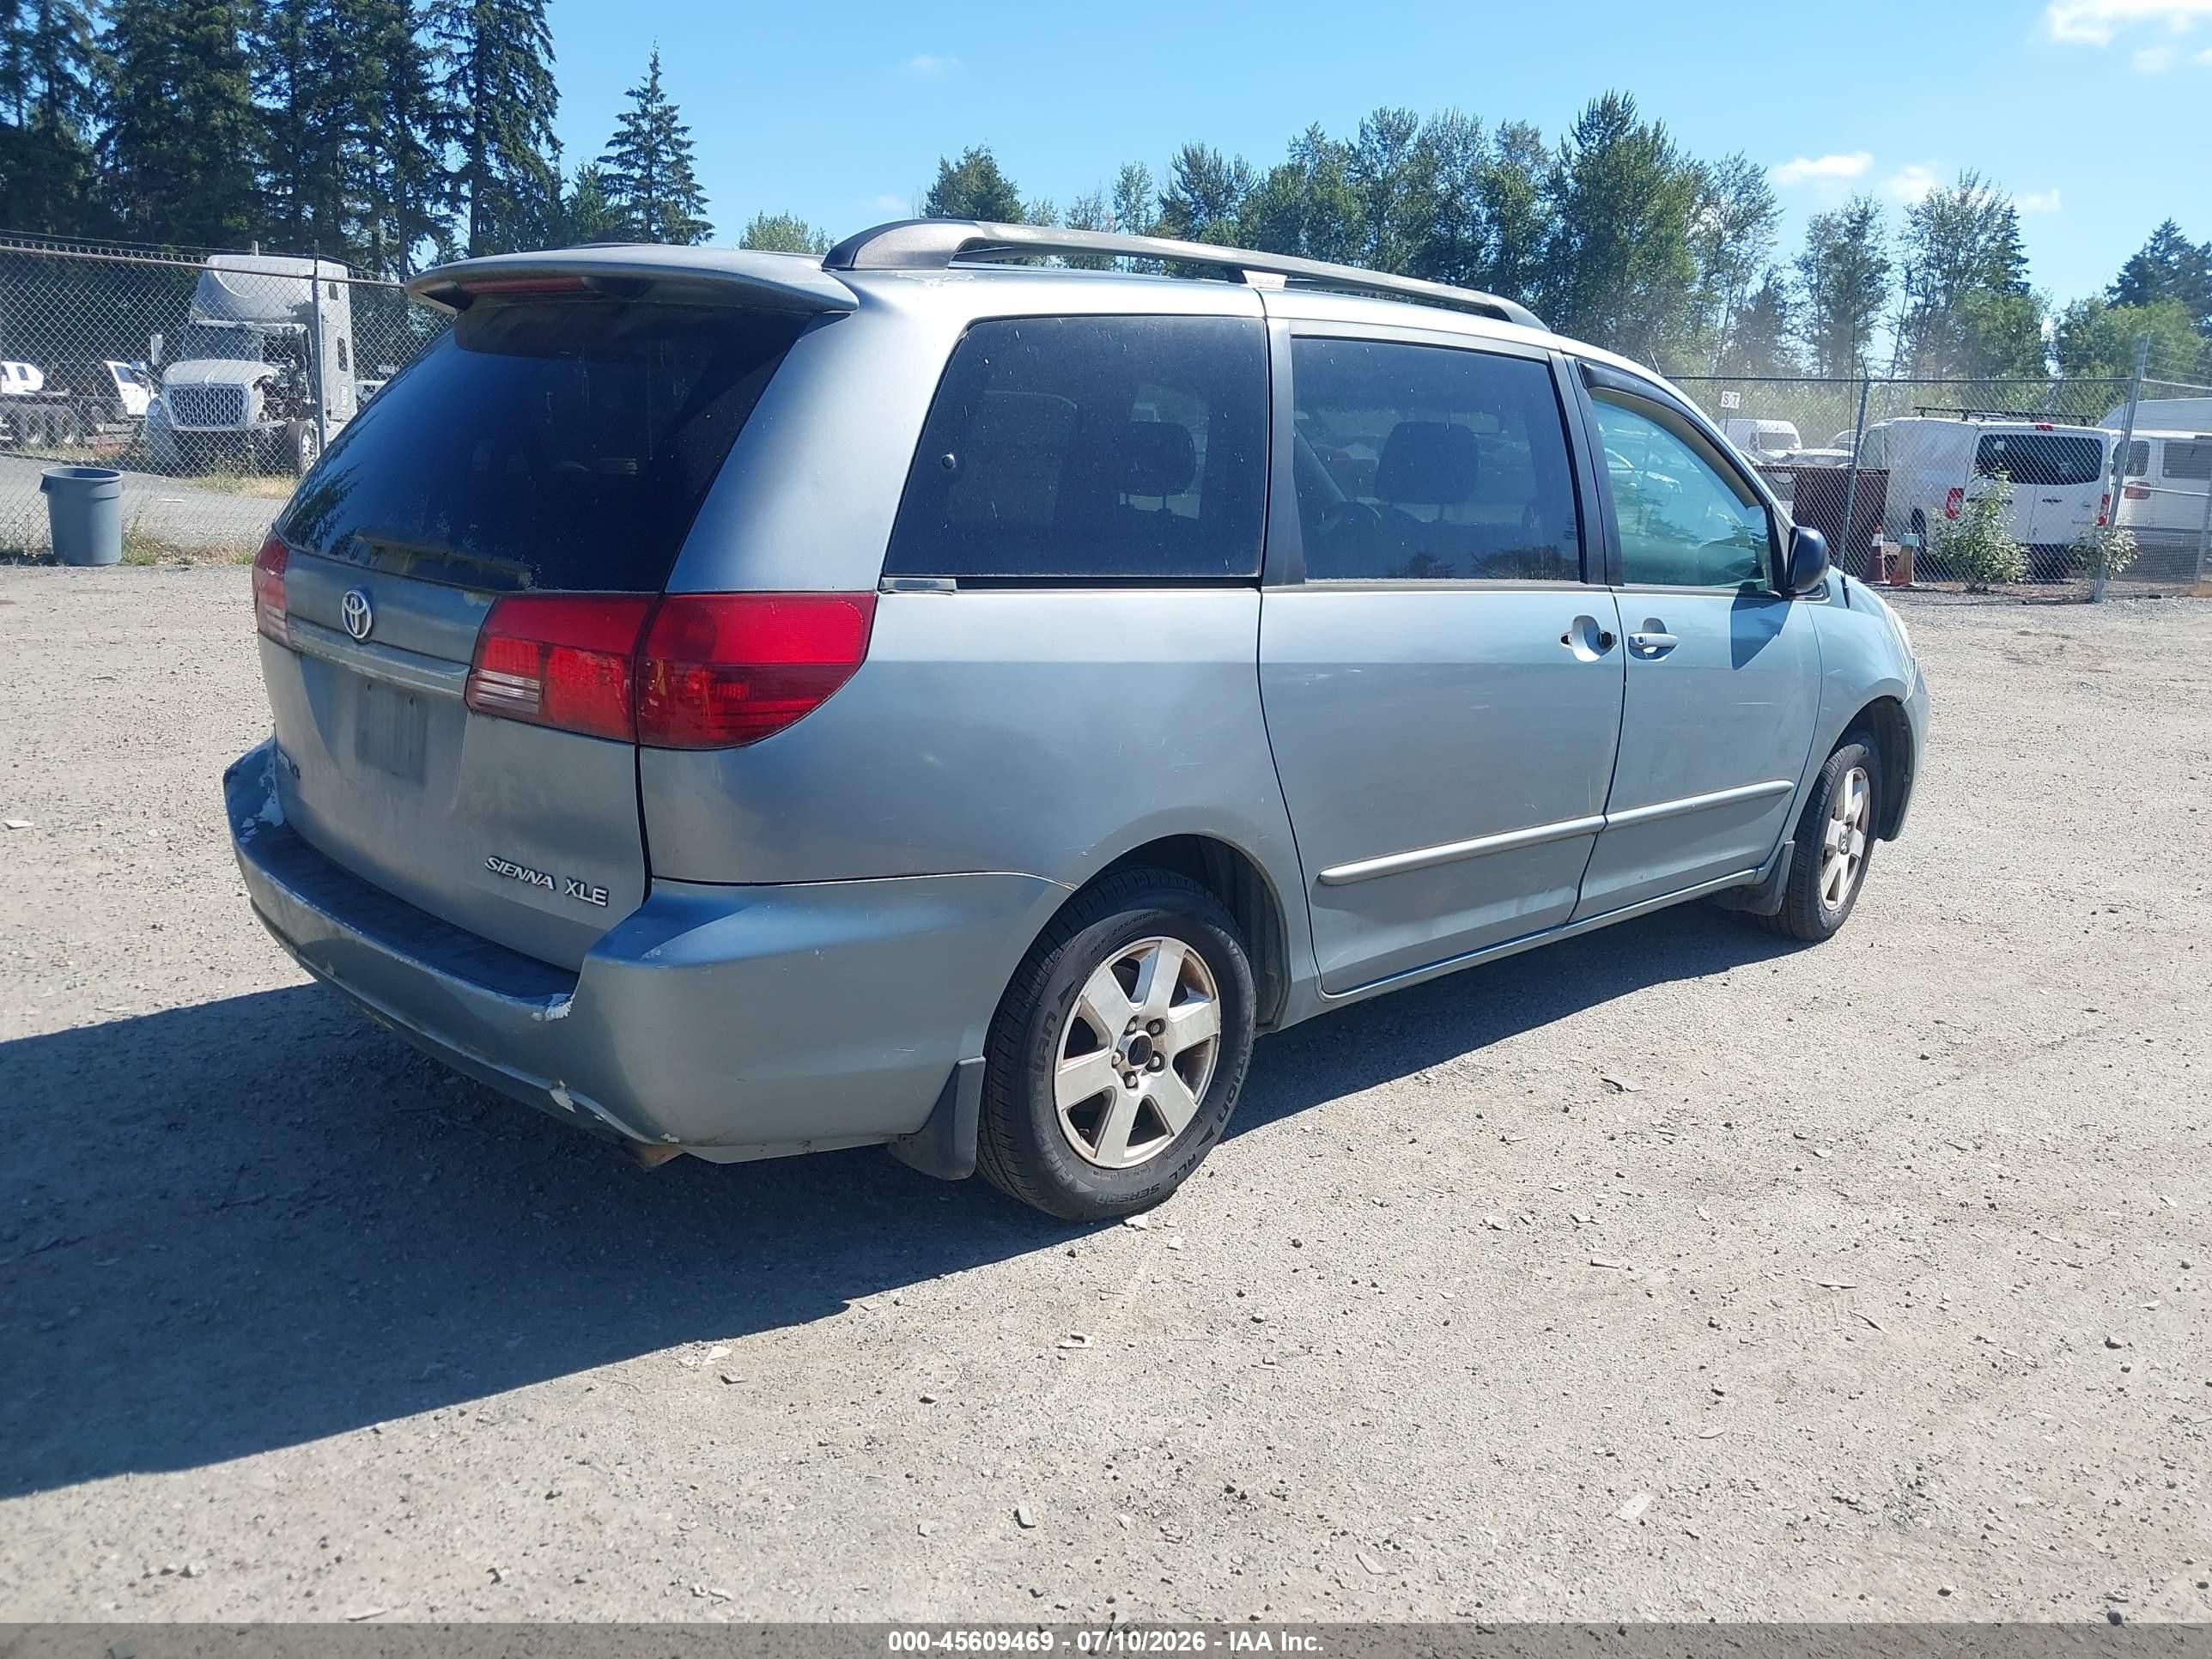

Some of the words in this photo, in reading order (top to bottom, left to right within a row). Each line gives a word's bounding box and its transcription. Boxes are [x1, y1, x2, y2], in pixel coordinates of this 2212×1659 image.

[484, 857, 556, 890] SIENNA
[564, 878, 608, 908] XLE
[1169, 1152, 1197, 1181] ALL
